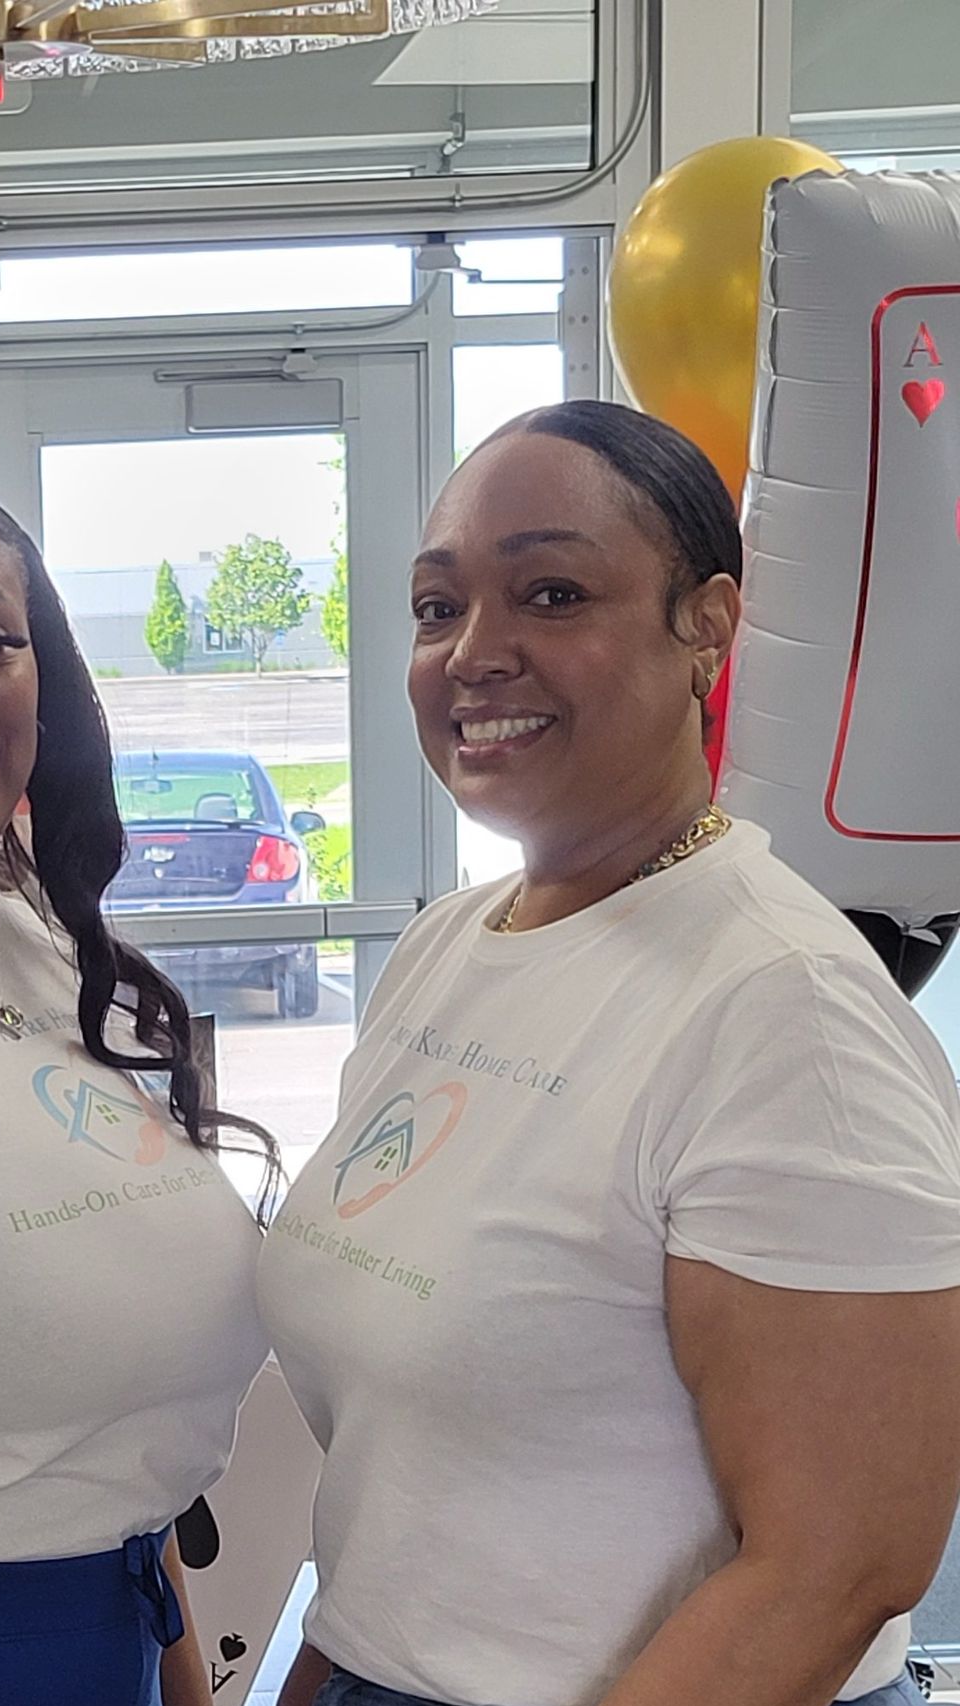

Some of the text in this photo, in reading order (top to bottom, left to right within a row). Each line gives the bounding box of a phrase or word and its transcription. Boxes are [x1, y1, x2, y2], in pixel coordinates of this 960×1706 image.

[902, 320, 944, 368] A
[8, 1190, 121, 1234] Hands-On
[122, 1181, 162, 1202] Care
[161, 1174, 187, 1195] for
[339, 1236, 383, 1275] Better
[380, 1256, 437, 1301] Living
[209, 1660, 239, 1695] A
